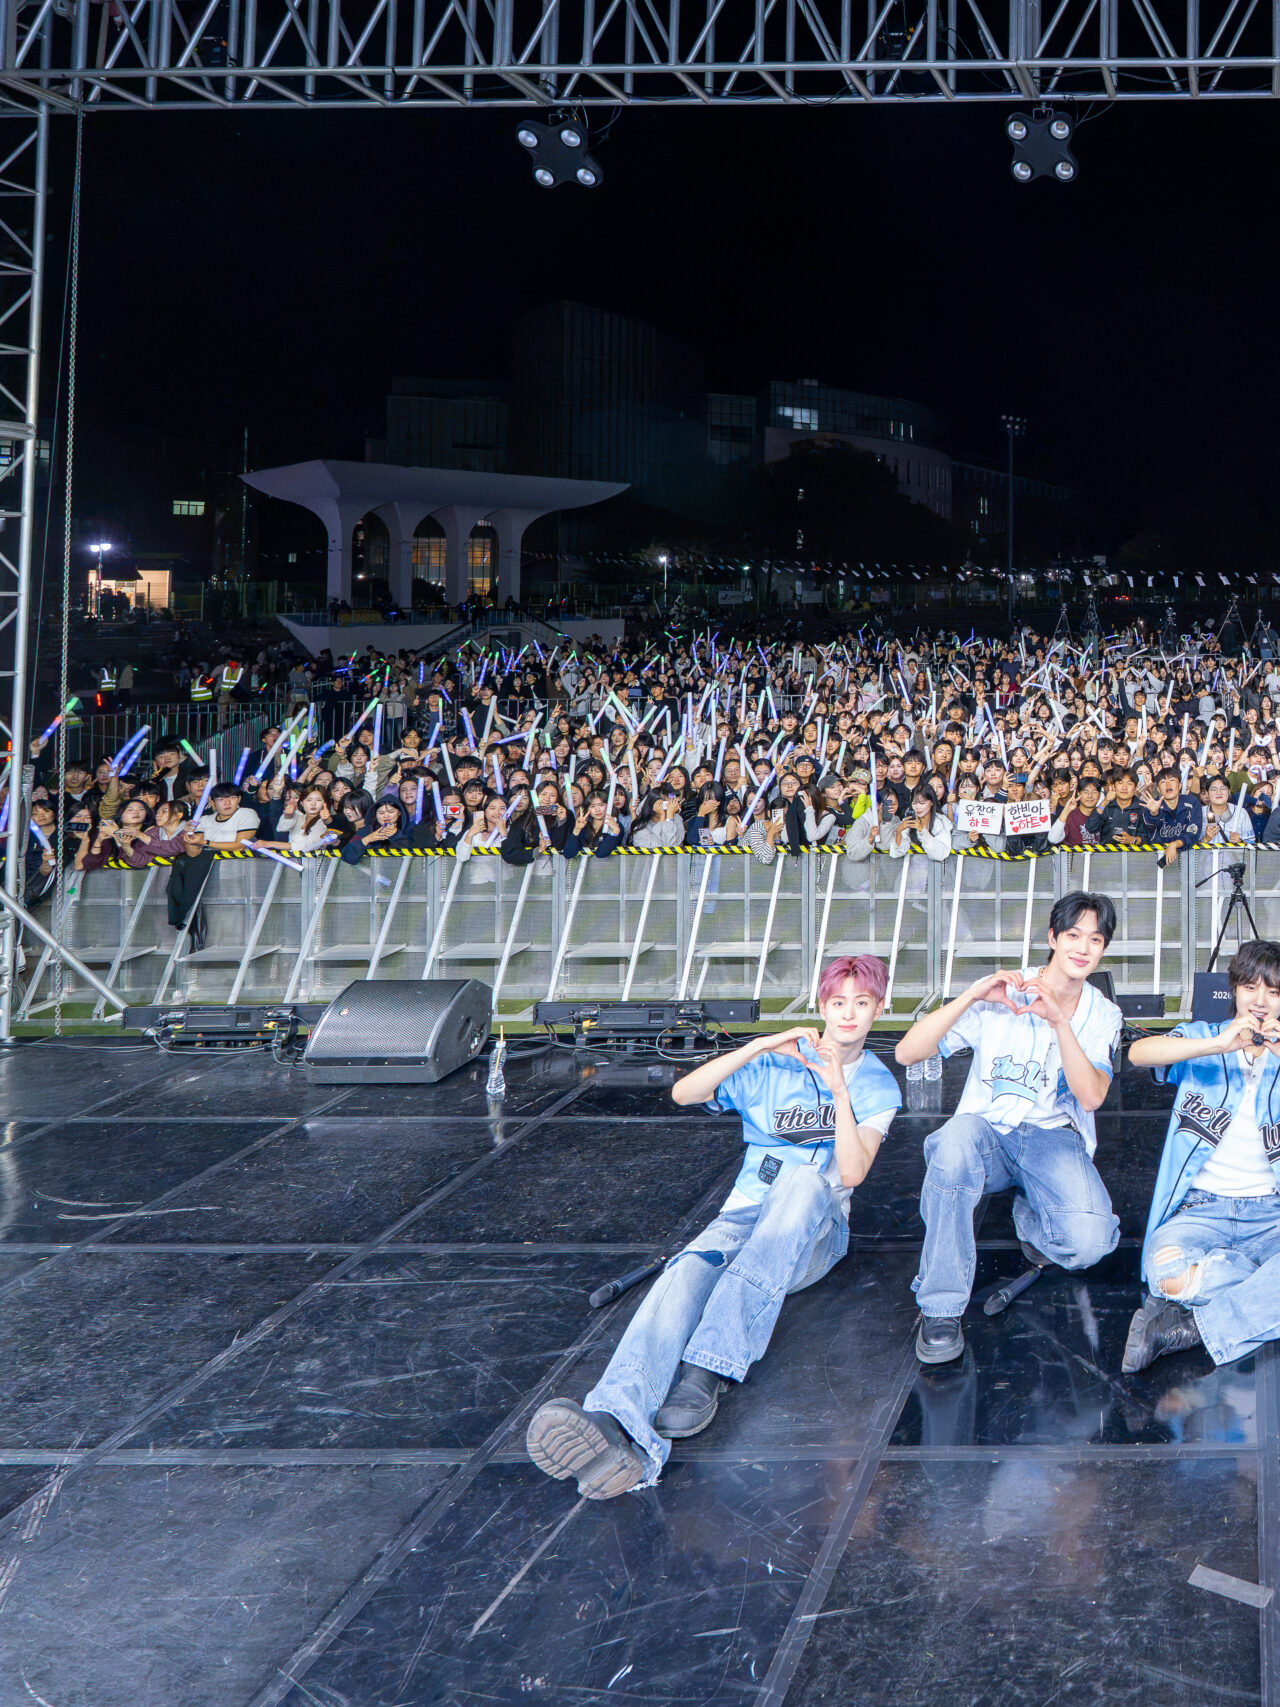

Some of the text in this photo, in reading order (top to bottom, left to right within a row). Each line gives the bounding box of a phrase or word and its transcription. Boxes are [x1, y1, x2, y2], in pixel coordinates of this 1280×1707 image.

[964, 803, 996, 817] 유찬아
[1007, 801, 1046, 821] 한빈아
[968, 816, 991, 828] 하트
[1017, 815, 1042, 830] 하트
[1181, 1090, 1214, 1123] The
[773, 1104, 818, 1131] The
